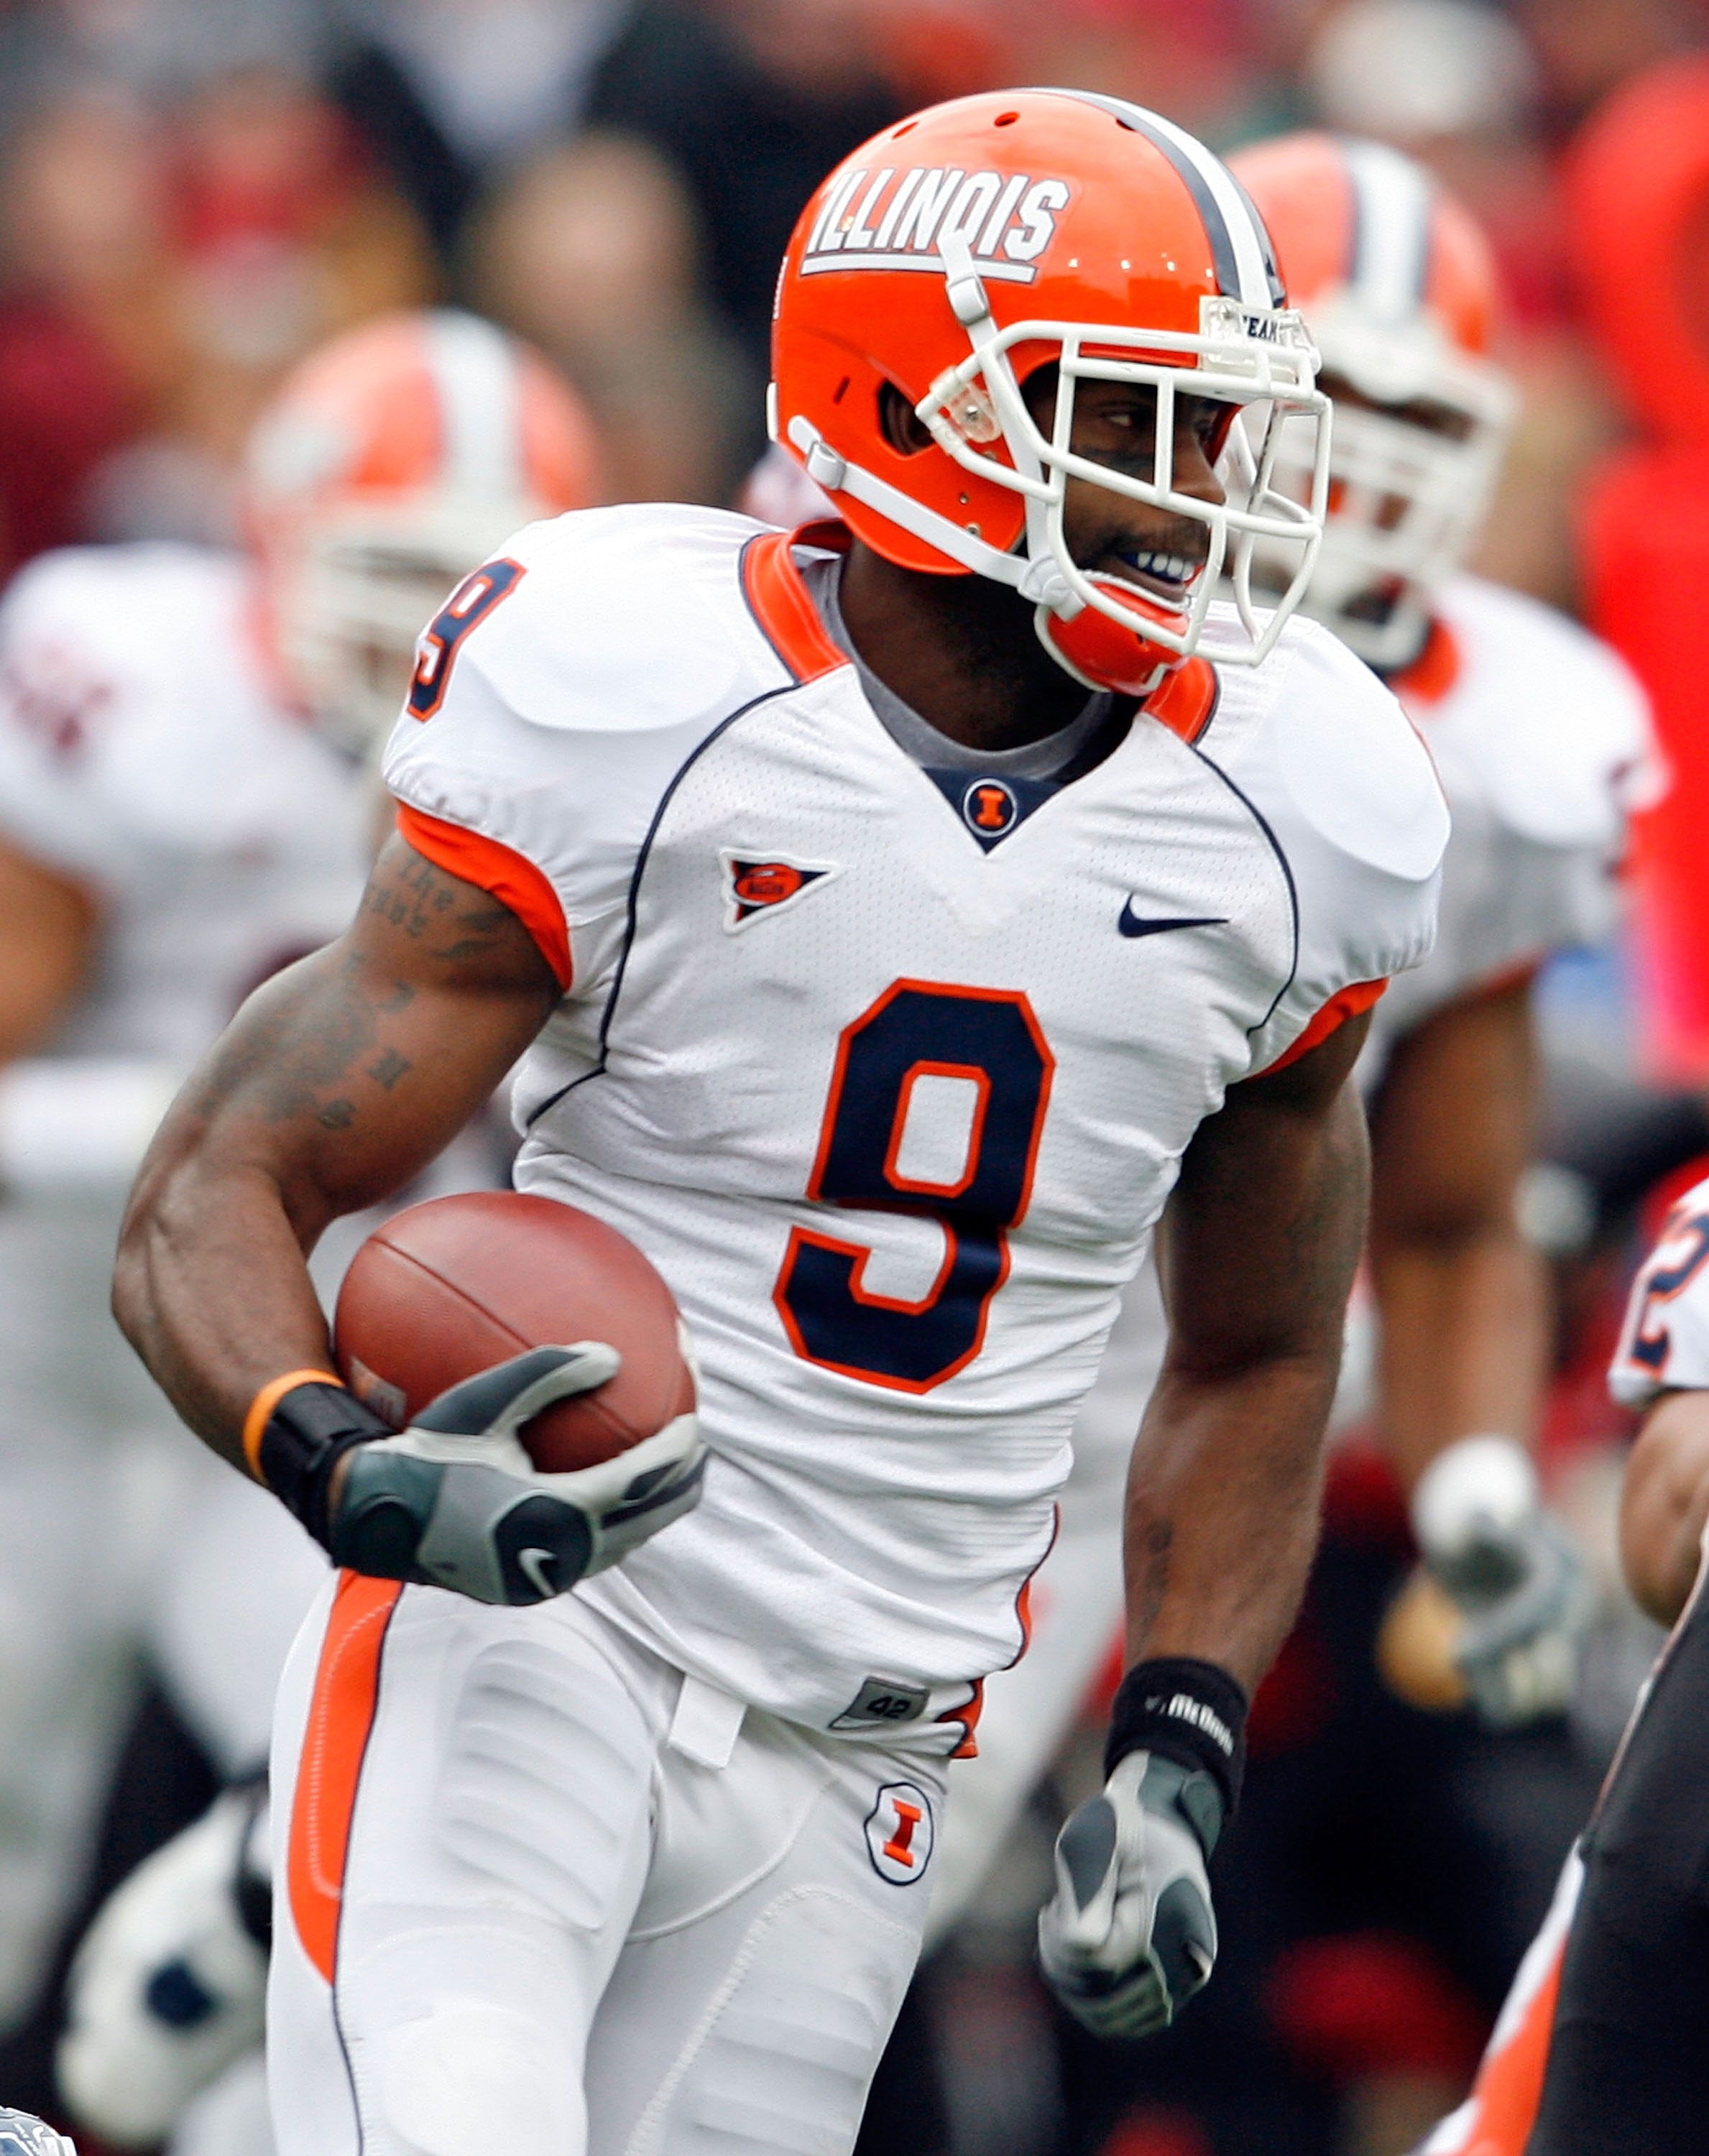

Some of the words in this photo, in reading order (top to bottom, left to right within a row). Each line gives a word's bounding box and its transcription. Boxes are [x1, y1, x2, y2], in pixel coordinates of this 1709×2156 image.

[806, 167, 1071, 262] ILLINOIS
[406, 557, 528, 723] 9
[976, 788, 1005, 826] I
[773, 977, 1056, 1394] 9
[867, 1696, 911, 1718] 42
[883, 1798, 922, 1868] I
